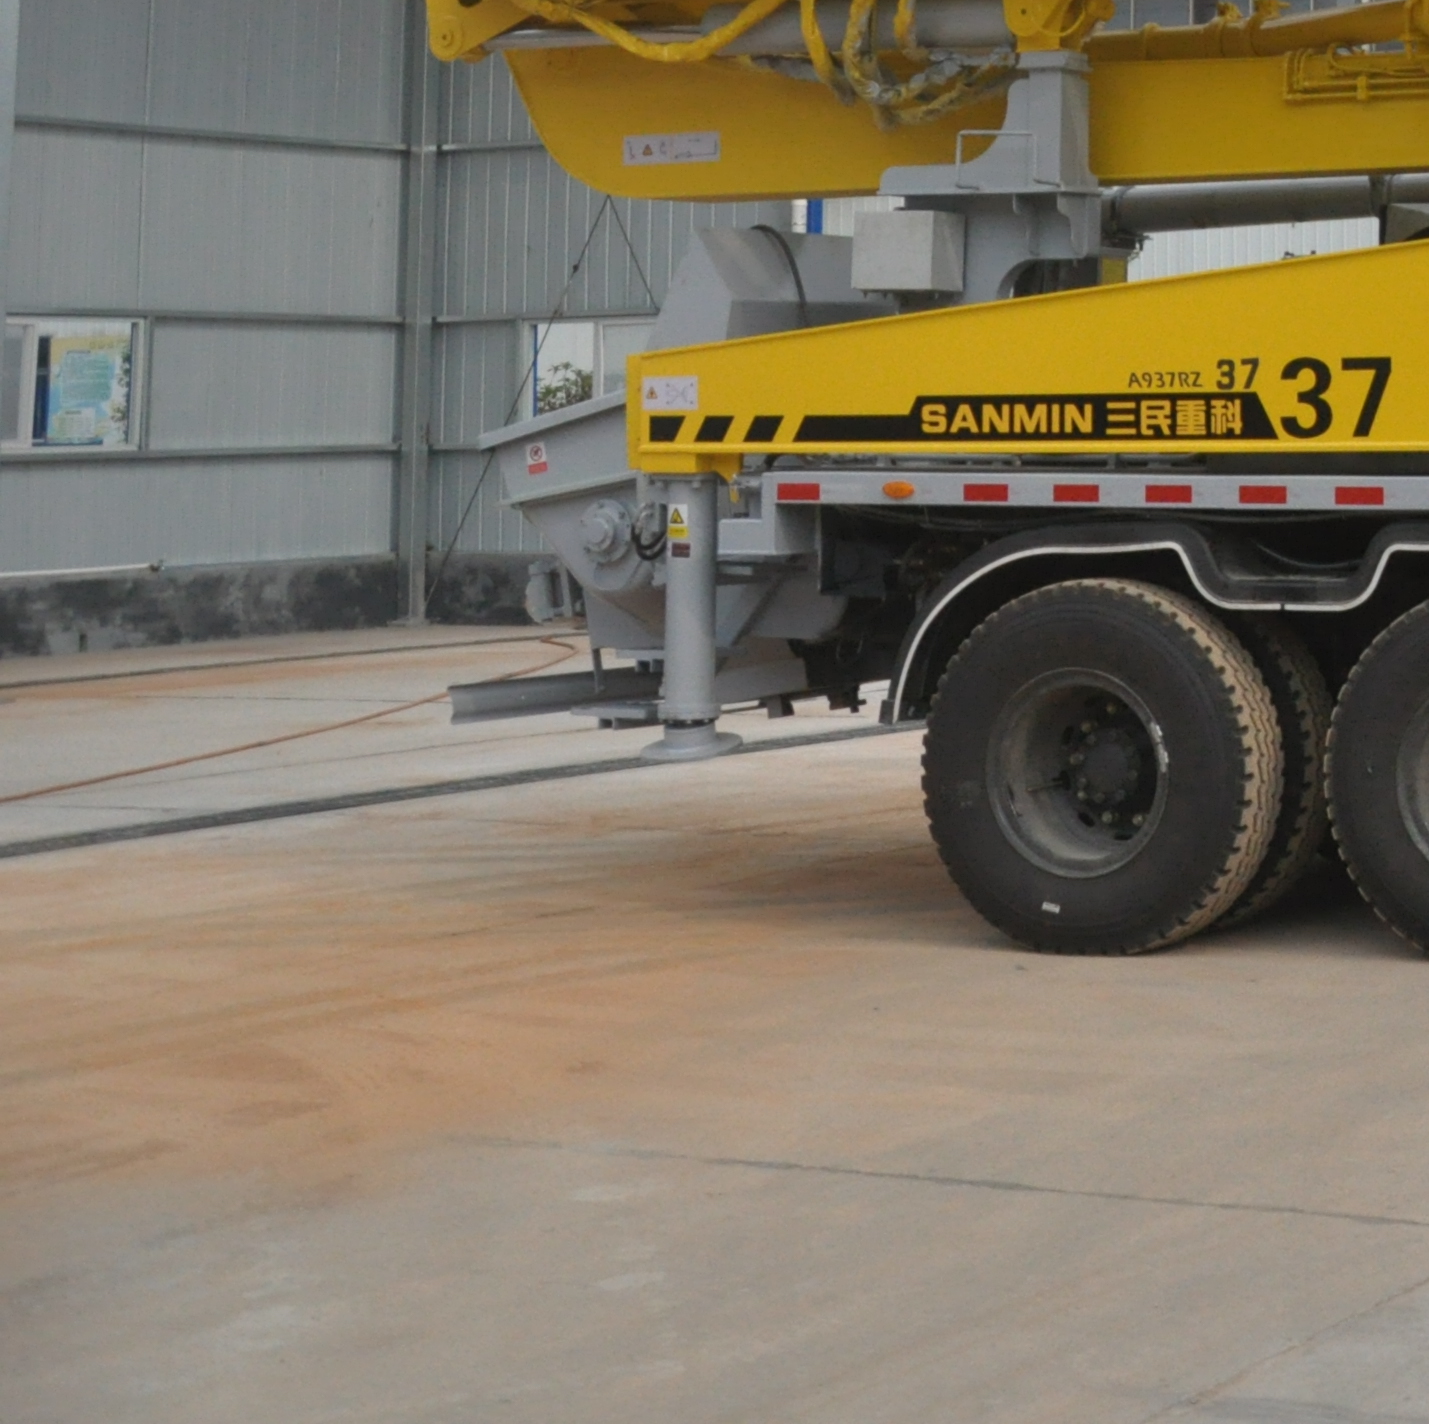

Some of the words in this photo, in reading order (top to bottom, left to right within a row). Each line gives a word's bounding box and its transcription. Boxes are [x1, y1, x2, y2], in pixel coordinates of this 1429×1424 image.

[1128, 372, 1204, 389] A937RZ
[1216, 358, 1260, 390] 37
[1280, 357, 1392, 438] 37
[921, 403, 1093, 434] SANMIN
[1106, 400, 1242, 435] 三民重科
